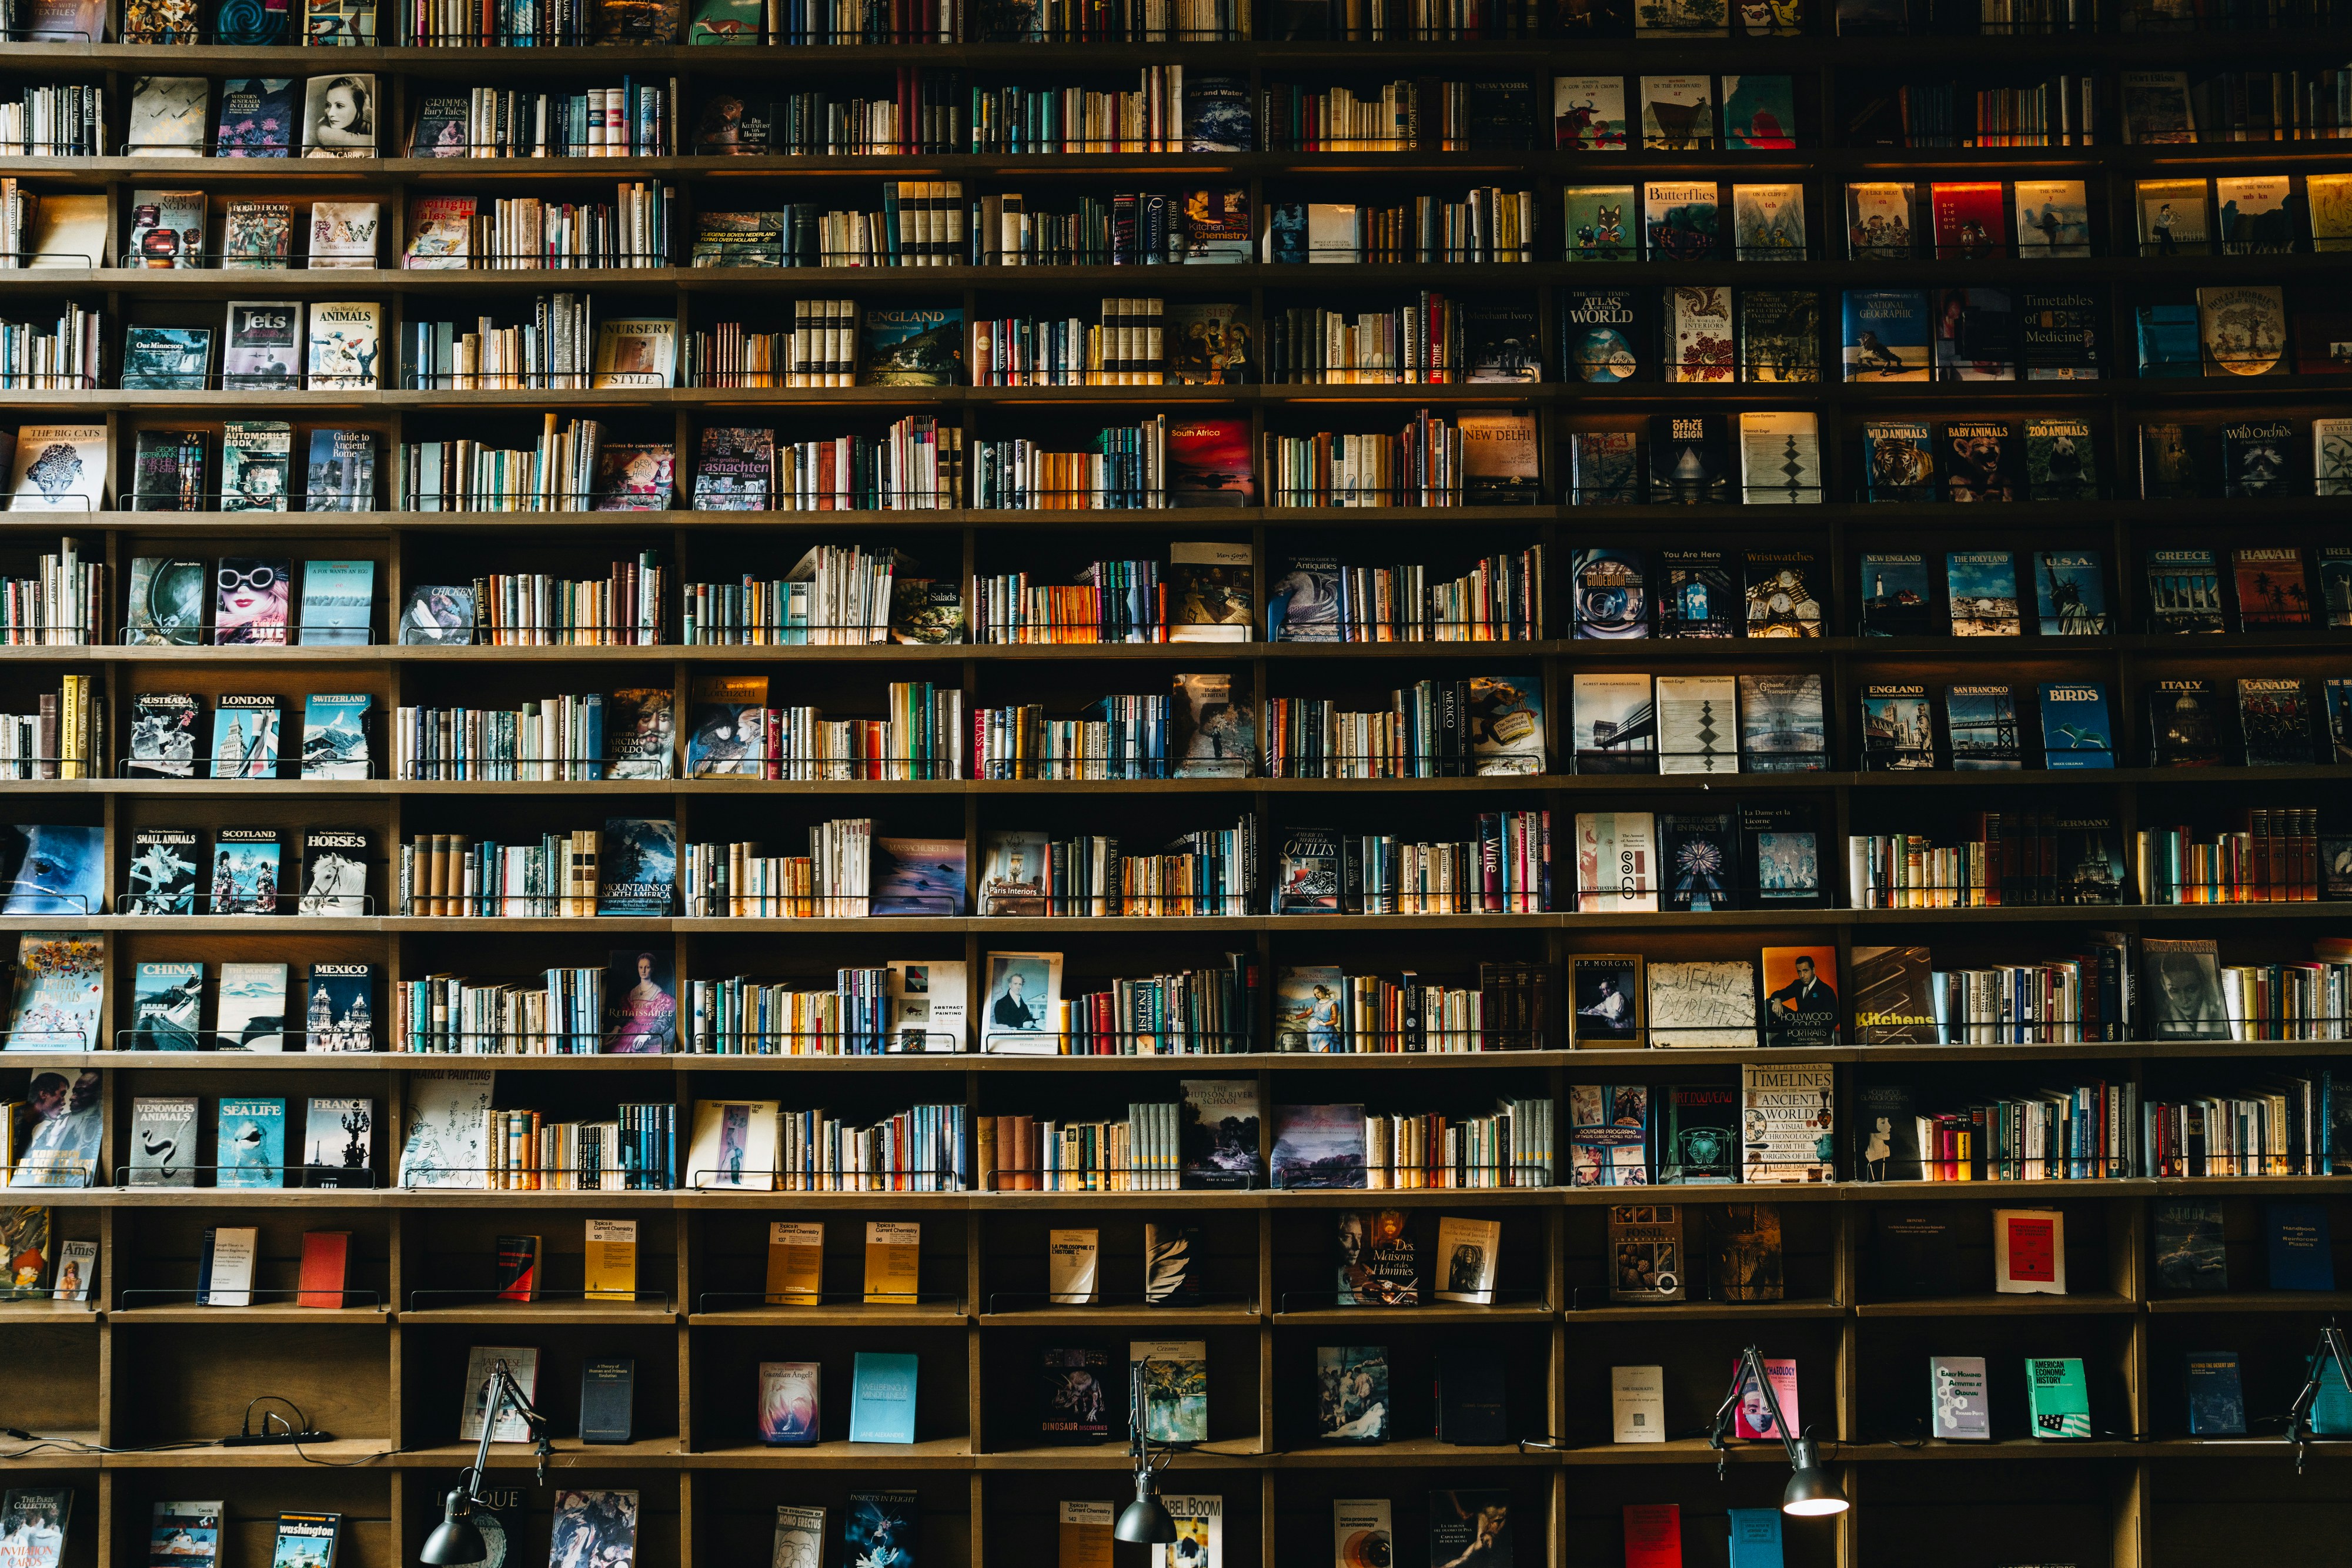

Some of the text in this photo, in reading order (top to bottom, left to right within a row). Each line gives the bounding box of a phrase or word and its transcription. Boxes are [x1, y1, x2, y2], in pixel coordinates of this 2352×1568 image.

[425, 98, 467, 108] GRIMM'S
[424, 107, 466, 116] Fairy Tales
[1649, 188, 1715, 202] Butterflies
[315, 220, 375, 242] RAW
[1189, 223, 1224, 232] Kitchen
[1195, 230, 1248, 241] Chemistry
[1581, 297, 1621, 310] ATLAS
[1867, 301, 1905, 309] NATIONAL
[2023, 295, 2093, 306] Timetables
[320, 312, 371, 321] ANIMALS
[867, 312, 944, 322] ENGLAND
[1571, 309, 1633, 324] WORLD
[1860, 309, 1913, 319] GEOGRAPHIC
[2024, 313, 2037, 323] of
[242, 312, 286, 333] Jets
[604, 325, 671, 334] NURSERY
[2026, 330, 2083, 342] Medicine
[610, 375, 654, 385] STYLE
[1465, 430, 1531, 440] NEW DELHI
[1868, 429, 1927, 439] WILD ANIMALS
[2227, 424, 2291, 439] Wild Orchids
[334, 433, 359, 442] Guide
[334, 442, 366, 450] Ancient
[333, 450, 356, 458] Rome
[698, 460, 769, 472] Fasnachten
[1747, 552, 1814, 563] Wristwatches
[2155, 551, 2210, 560] GREECE
[2240, 549, 2296, 560] HAWAII
[1296, 561, 1337, 571] Antiquities
[2046, 557, 2093, 566] U.S.A.
[1587, 574, 1625, 586] GUIDEBOOK
[432, 587, 475, 597] CHICKEN
[930, 593, 956, 602] Salads
[222, 696, 274, 705] LONDON
[2049, 690, 2099, 701] BIRDS
[1445, 691, 1454, 728] MEXICO
[609, 738, 639, 746] ARCIM
[612, 745, 643, 754] BOLDO
[136, 834, 195, 844] SMALL ANIMALS
[308, 836, 366, 848] HORSES
[1280, 842, 1337, 856] QUILTS
[1486, 838, 1499, 873] Wine
[602, 883, 659, 891] MOUNTAINS
[990, 887, 1037, 896] Paris Interiors
[142, 965, 196, 974] CHINA
[315, 965, 368, 974] MEXICO
[1781, 1012, 1832, 1021] HOLLYWOOD
[1855, 1012, 1935, 1027] Kitchens
[1749, 1070, 1831, 1088] TIMELINES
[1188, 1091, 1253, 1099] HUDSON RIVER
[1762, 1094, 1818, 1105] ANCIENT
[314, 1099, 366, 1109] FRANCE
[1203, 1097, 1237, 1105] SCHOOL
[136, 1104, 195, 1114] VENOMOUS
[223, 1105, 282, 1116] SEA LIFE
[1766, 1109, 1813, 1119] WORLD
[140, 1113, 191, 1121] ANIMALS
[63, 1243, 95, 1257] Amis
[1374, 1251, 1414, 1262] Maisons
[1372, 1266, 1414, 1277] Hommes
[1043, 1422, 1078, 1431] DINOSAUR
[850, 1493, 879, 1502] INSECTS
[14, 1502, 57, 1510] COLLECTIONS
[1189, 1497, 1220, 1516] BOOM
[779, 1513, 821, 1530] HOMO ERECTUS
[280, 1523, 334, 1537] washington
[1, 1546, 53, 1557] INVITATION
[8, 1556, 42, 1567] CARDS
